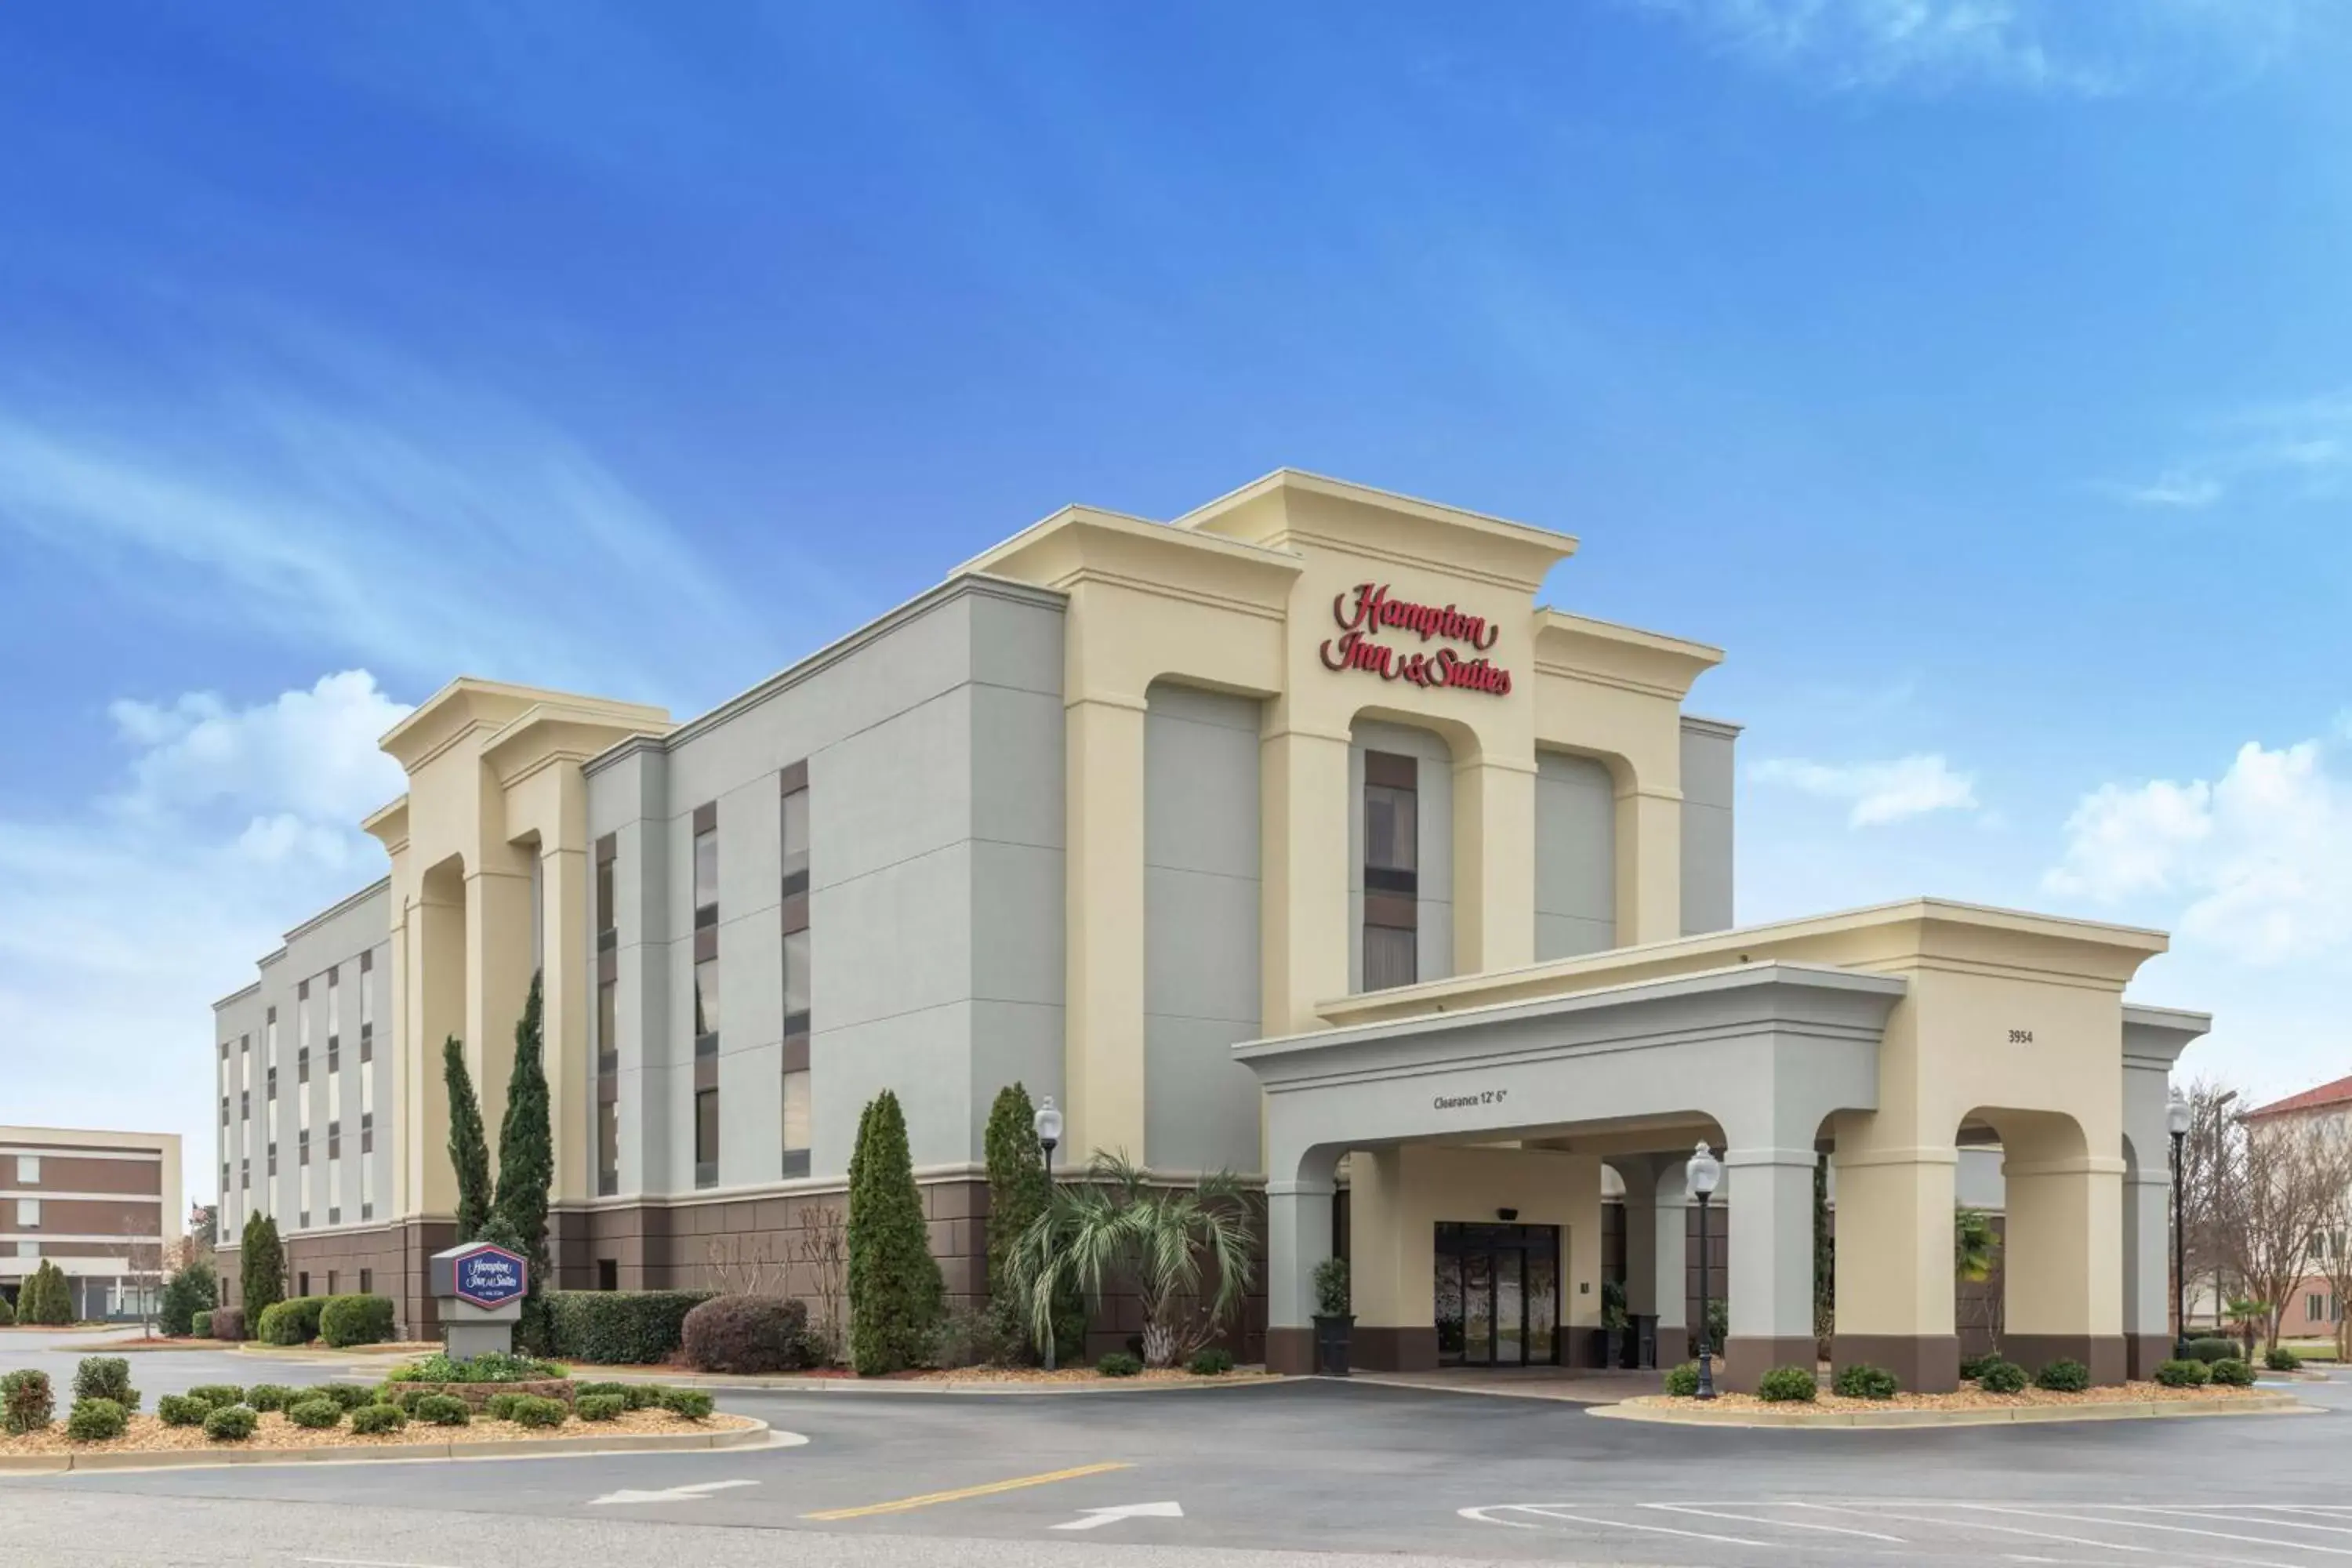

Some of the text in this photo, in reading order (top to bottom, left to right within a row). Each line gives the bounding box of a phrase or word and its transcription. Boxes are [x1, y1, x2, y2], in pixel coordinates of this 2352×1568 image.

[1334, 583, 1499, 650] Hampton
[1319, 630, 1512, 695] Inn & Suites
[2008, 1029, 2033, 1044] 3954
[1434, 1096, 1479, 1109] Clearance
[468, 1259, 512, 1275] Hampton
